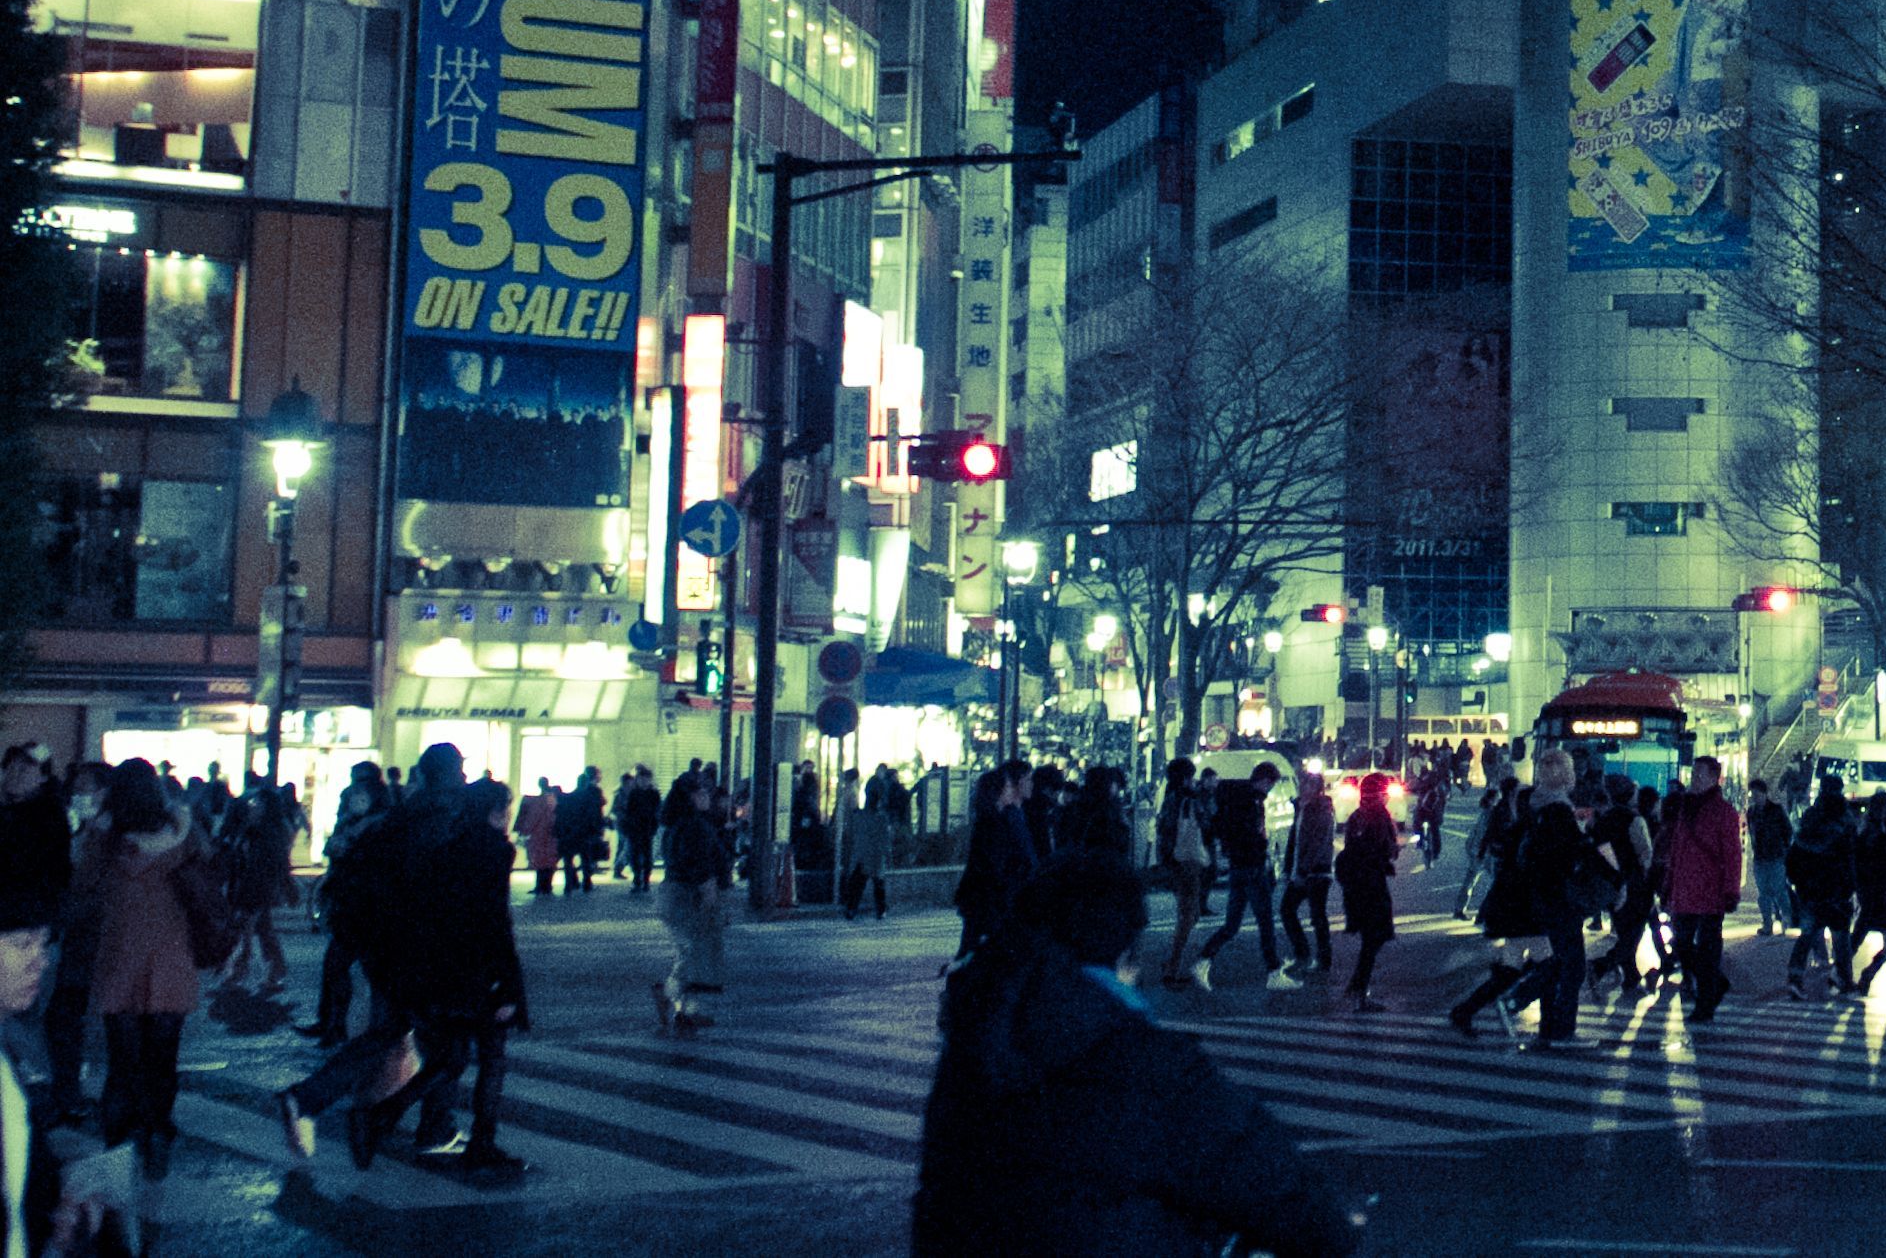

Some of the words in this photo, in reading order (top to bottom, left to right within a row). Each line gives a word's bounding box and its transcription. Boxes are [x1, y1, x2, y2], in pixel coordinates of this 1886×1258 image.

[417, 160, 635, 282] 3.9
[415, 278, 482, 331] ON
[489, 285, 631, 342] SALE!!
[968, 215, 995, 369] 洋装生地
[961, 413, 995, 581] マナン
